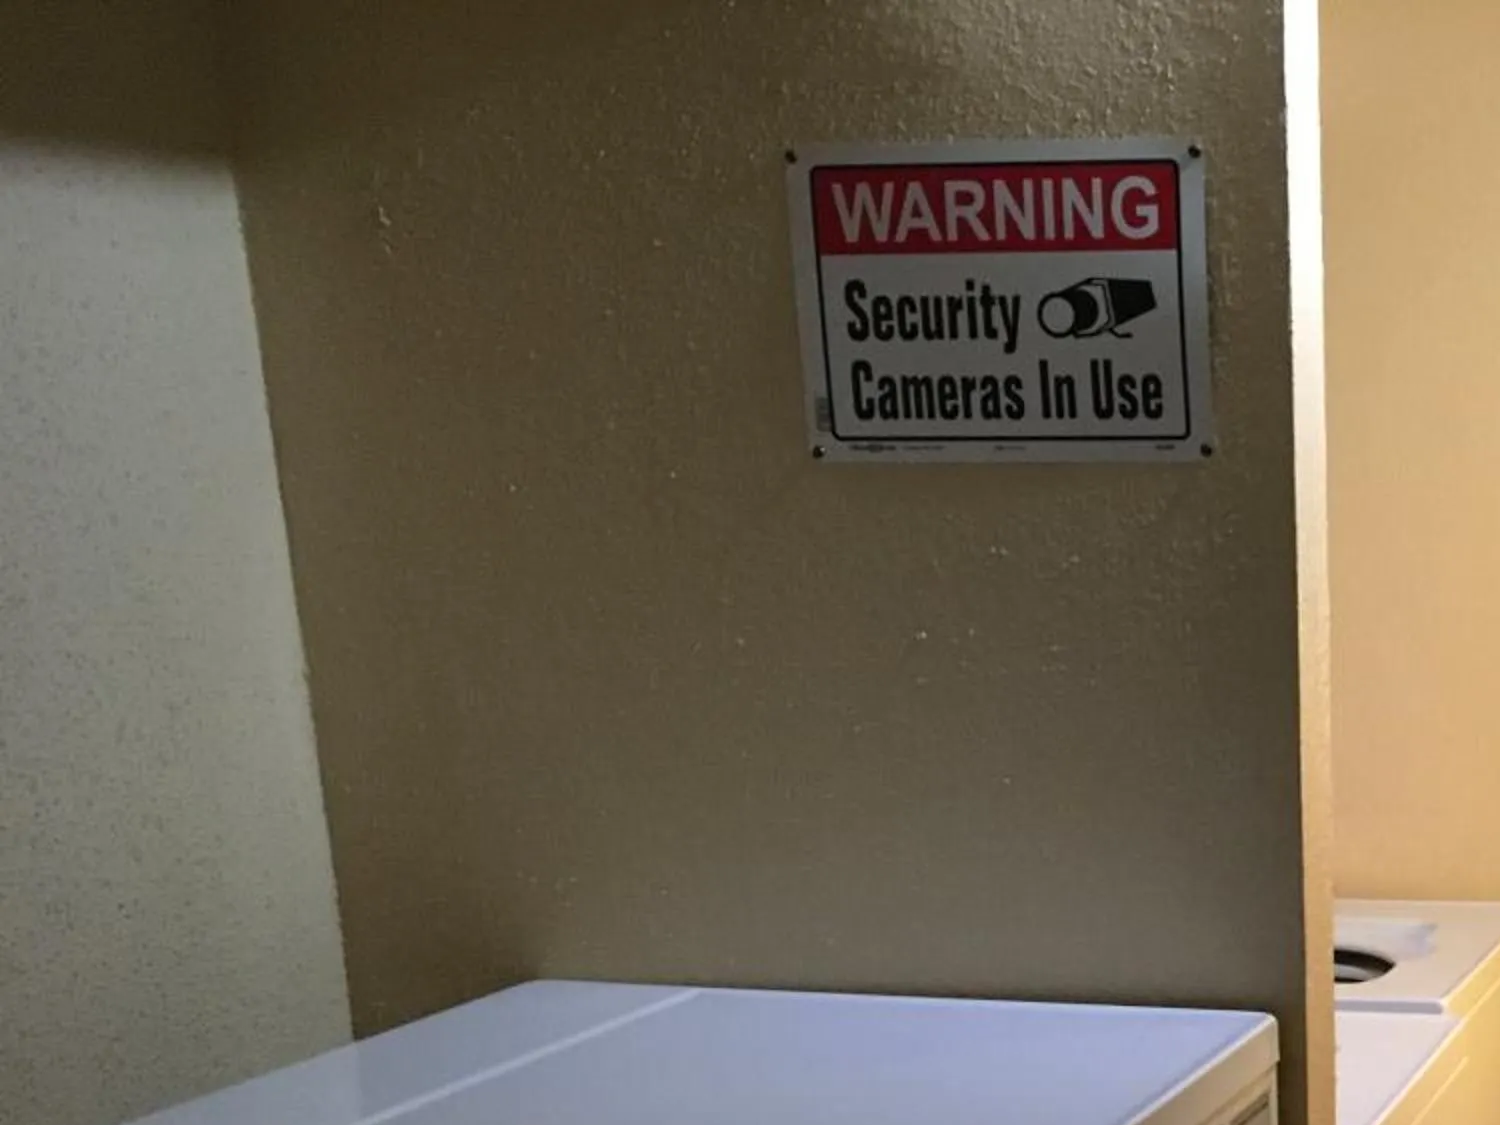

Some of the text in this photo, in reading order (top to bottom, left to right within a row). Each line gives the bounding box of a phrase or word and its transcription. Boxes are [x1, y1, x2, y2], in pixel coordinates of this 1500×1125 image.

[831, 175, 1160, 243] WARNING
[844, 278, 1021, 354] Security
[850, 358, 1163, 422] Cameras In Use
